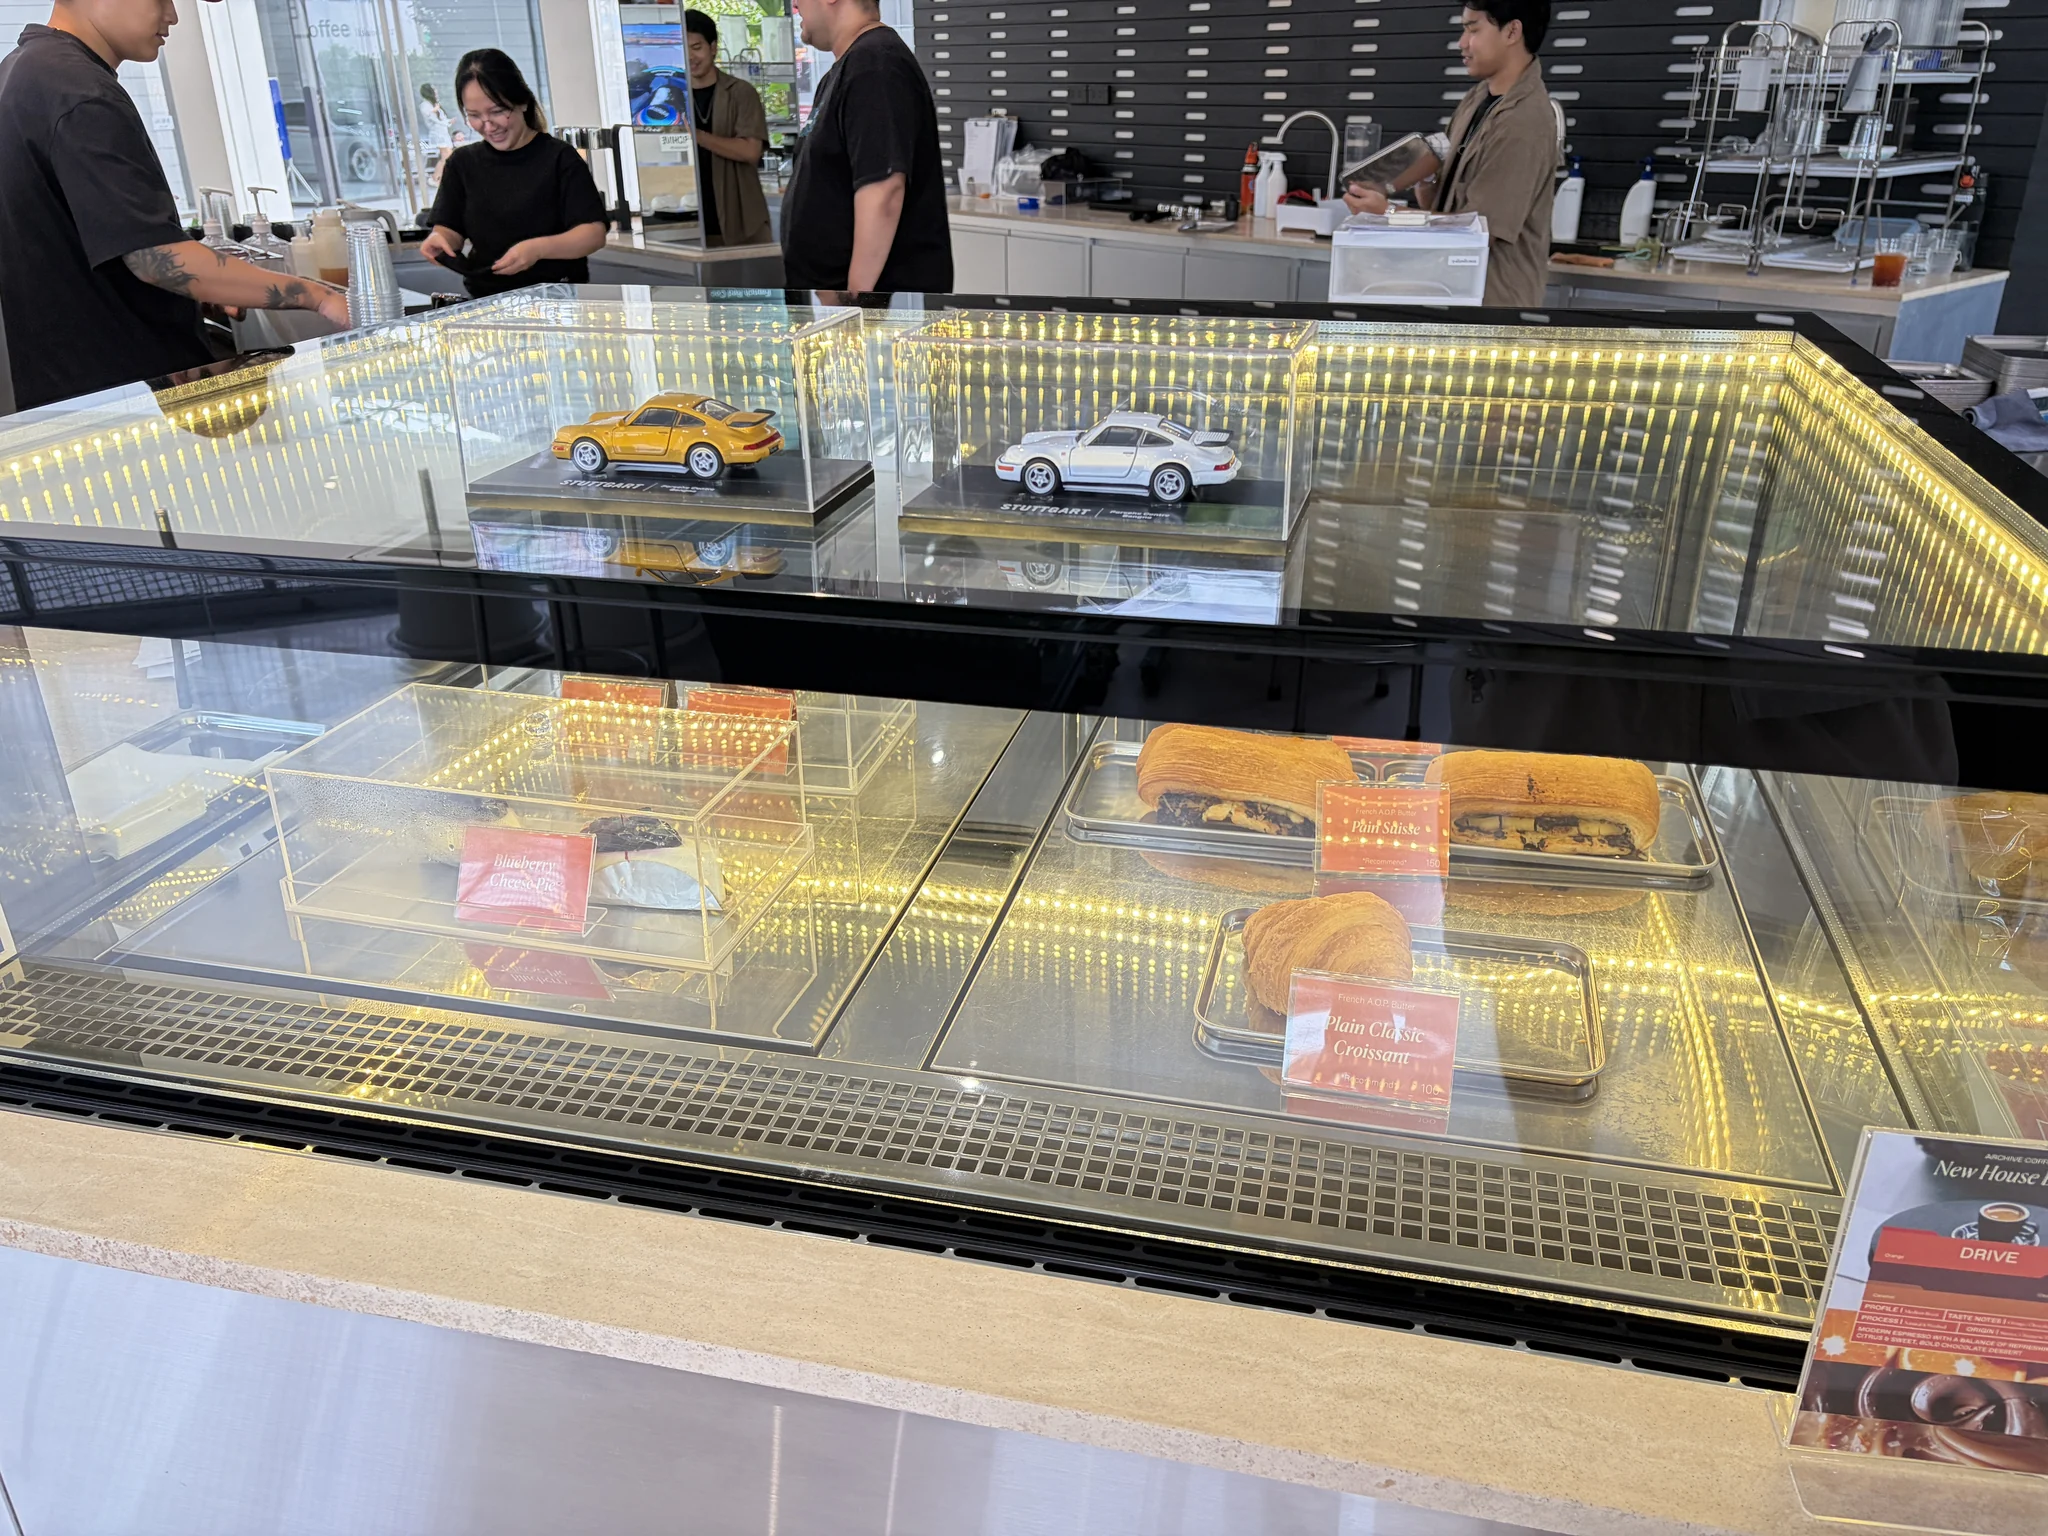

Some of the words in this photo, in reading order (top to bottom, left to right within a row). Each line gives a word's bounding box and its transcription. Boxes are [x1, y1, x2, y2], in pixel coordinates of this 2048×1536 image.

[308, 19, 351, 38] offee
[560, 479, 645, 490] STUTTGART
[1000, 503, 1091, 515] STUTTGART
[1351, 820, 1380, 833] Pain
[1382, 821, 1421, 835] Suisse
[493, 853, 556, 873] Blueberry
[490, 873, 533, 889] Cheese
[535, 877, 556, 891] Pie
[1338, 994, 1365, 1005] French
[1367, 997, 1390, 1008] A.O.P.
[1391, 1001, 1416, 1011] Butter
[1324, 1015, 1366, 1036] Plain
[1369, 1020, 1425, 1043] Classic
[1333, 1039, 1411, 1064] Croissant
[1421, 1083, 1441, 1096] 100
[1984, 1153, 2023, 1163] ARCHIVE
[2024, 1156, 2048, 1165] COFF
[1933, 1159, 1978, 1179] New
[1979, 1163, 2041, 1185] House
[1959, 1246, 2020, 1264] DRIVE
[1864, 1303, 1899, 1313] PROFILE
[1861, 1314, 1899, 1325] PROCESS
[1948, 1313, 1973, 1321] TASTE
[1975, 1316, 2002, 1324] NOTES
[1857, 1326, 1892, 1335] MODERN
[1892, 1330, 1931, 1340] ESPRESSO
[1960, 1338, 1995, 1347] BALANCE
[1966, 1326, 1995, 1334] ORIGIN
[1856, 1333, 1883, 1341] CITRUS
[1919, 1340, 1940, 1348] BOLD
[1941, 1342, 1988, 1352] CHOCOLATE
[1988, 1347, 2023, 1356] DESSERT
